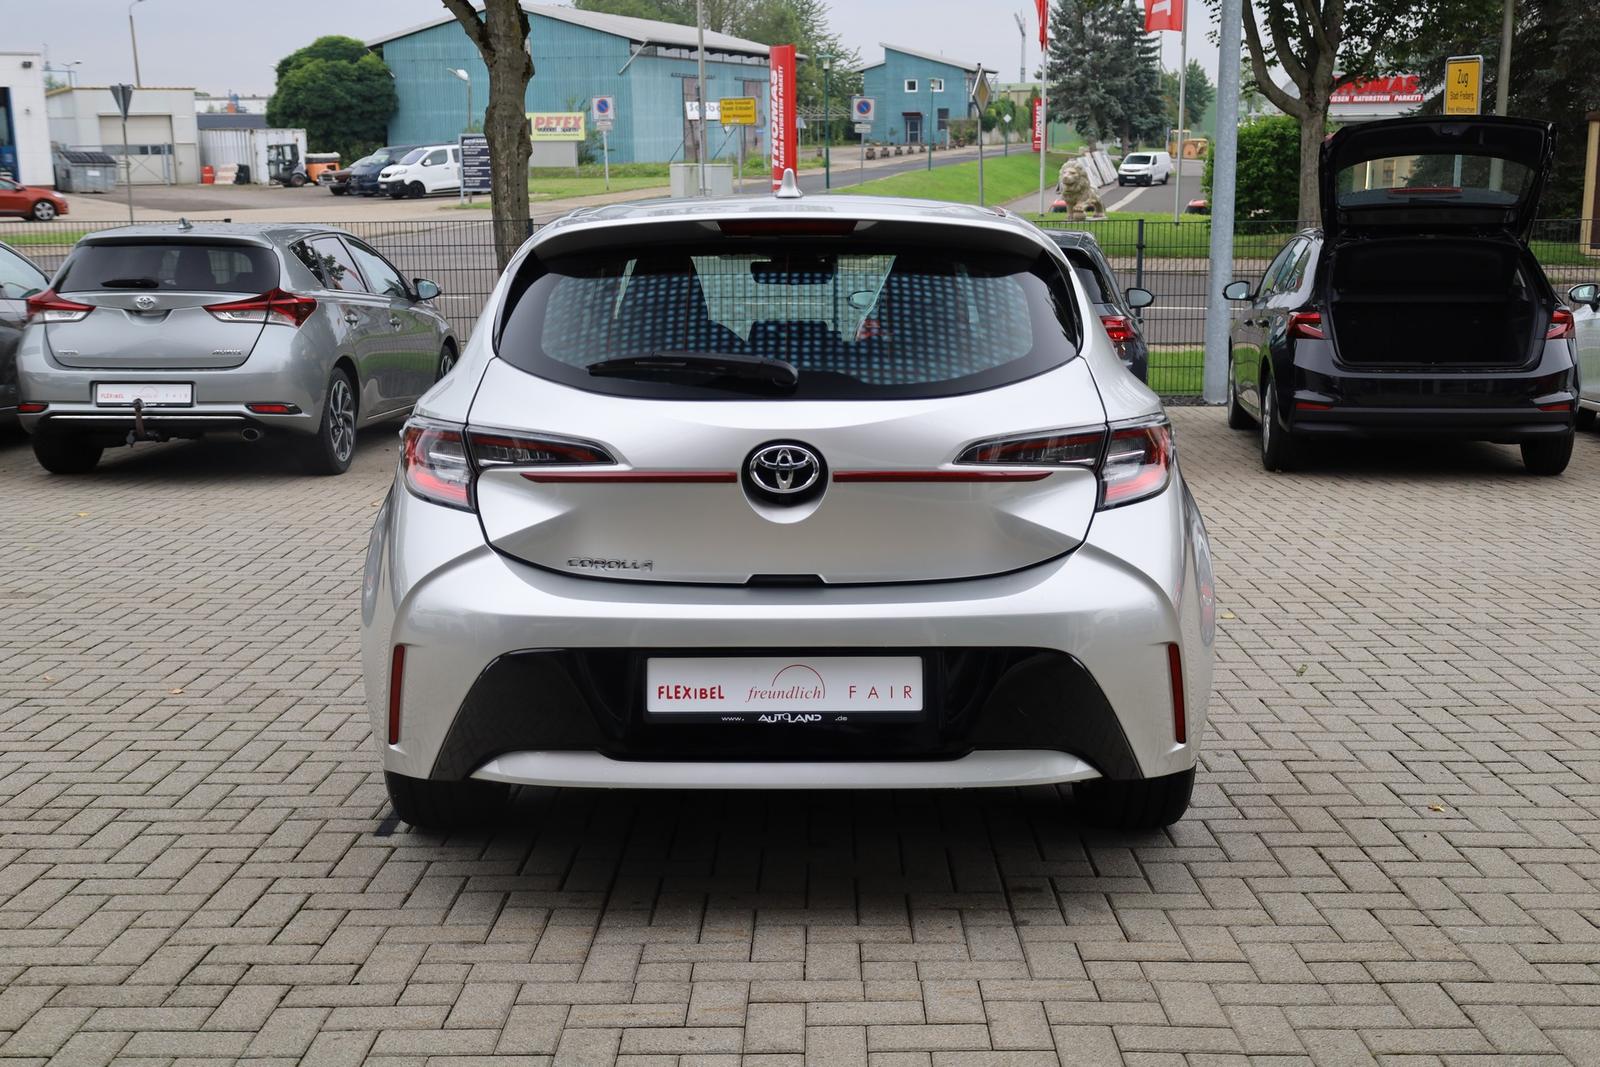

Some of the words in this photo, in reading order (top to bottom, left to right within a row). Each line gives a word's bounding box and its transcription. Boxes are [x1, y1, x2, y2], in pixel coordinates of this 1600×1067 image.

[1457, 69, 1468, 87] Zug
[535, 116, 582, 129] PETEX
[771, 70, 779, 168] THOMAS
[566, 558, 654, 572] COROLLA
[657, 684, 725, 700] FLEXIBEL
[745, 685, 823, 703] freundlich
